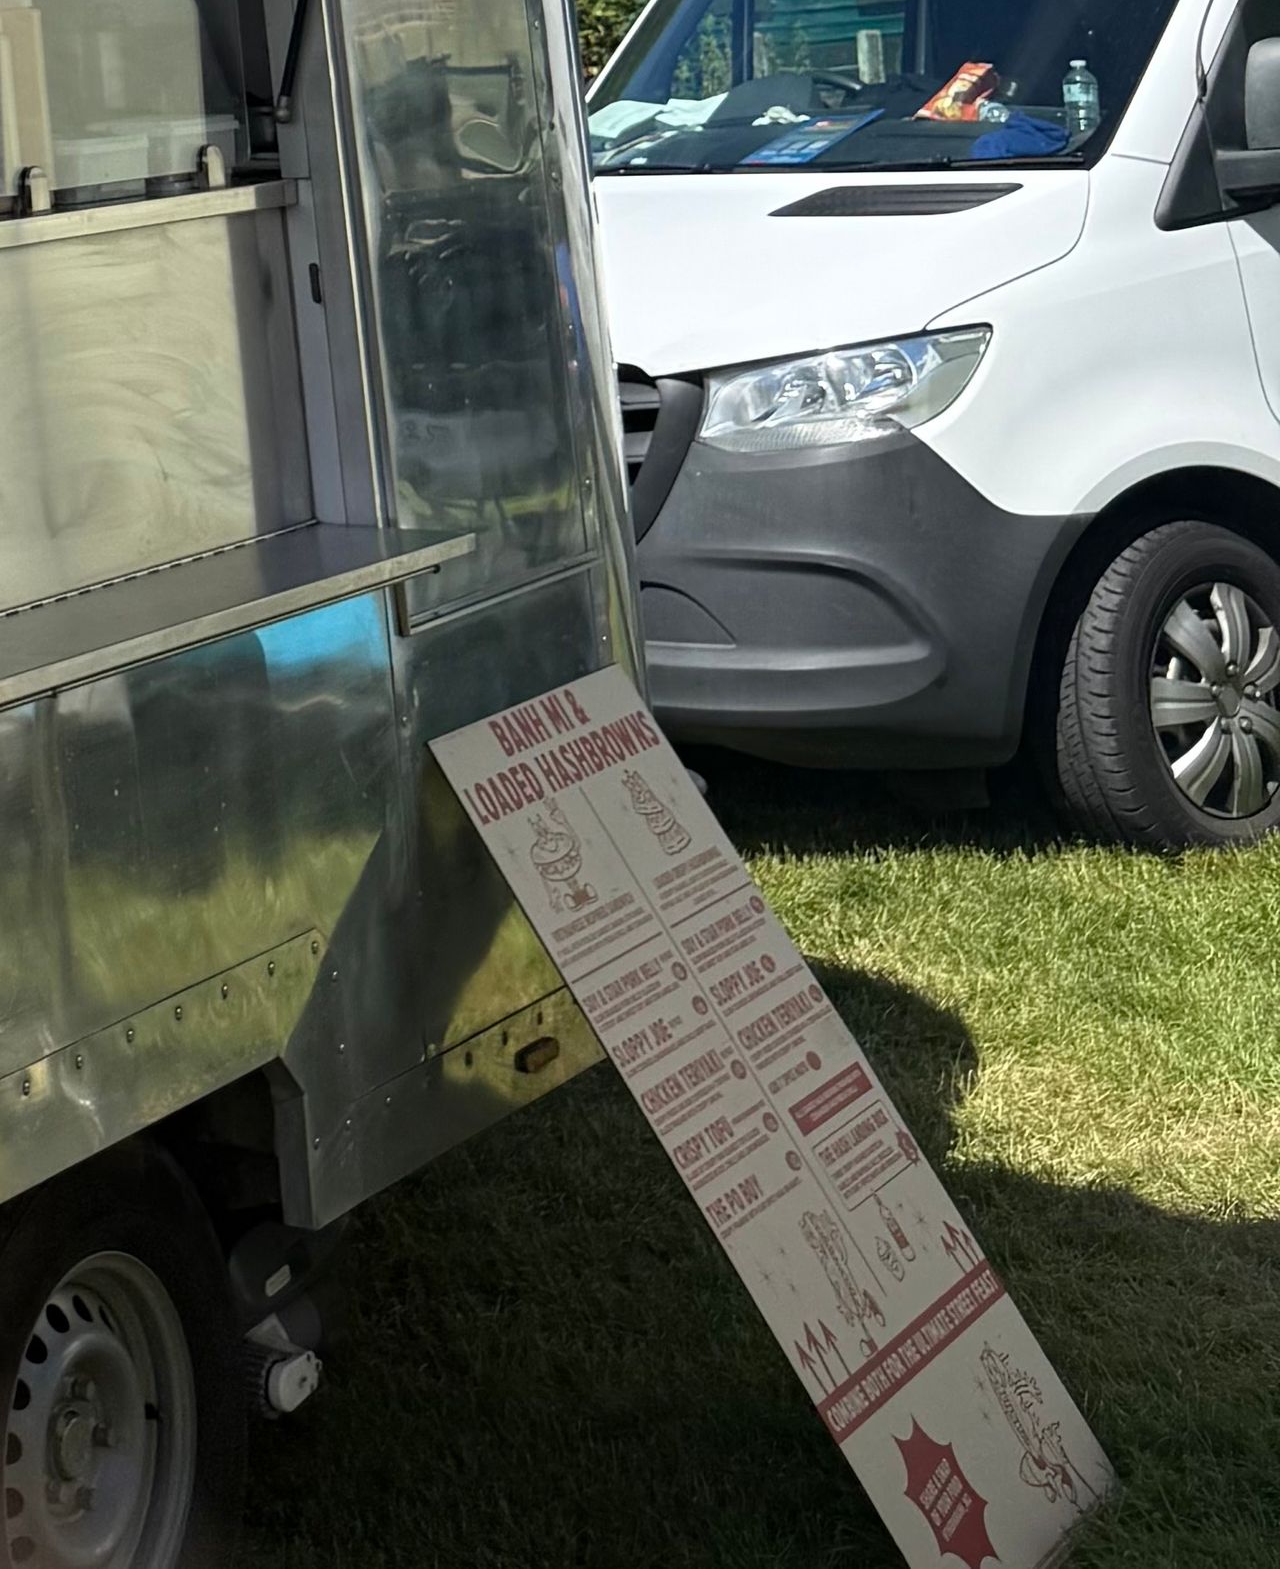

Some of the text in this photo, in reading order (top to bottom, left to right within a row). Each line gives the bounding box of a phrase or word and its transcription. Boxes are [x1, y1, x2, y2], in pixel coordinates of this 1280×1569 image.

[489, 690, 588, 754] BANH MI &
[464, 712, 660, 823] LOADED HASHBROWNS
